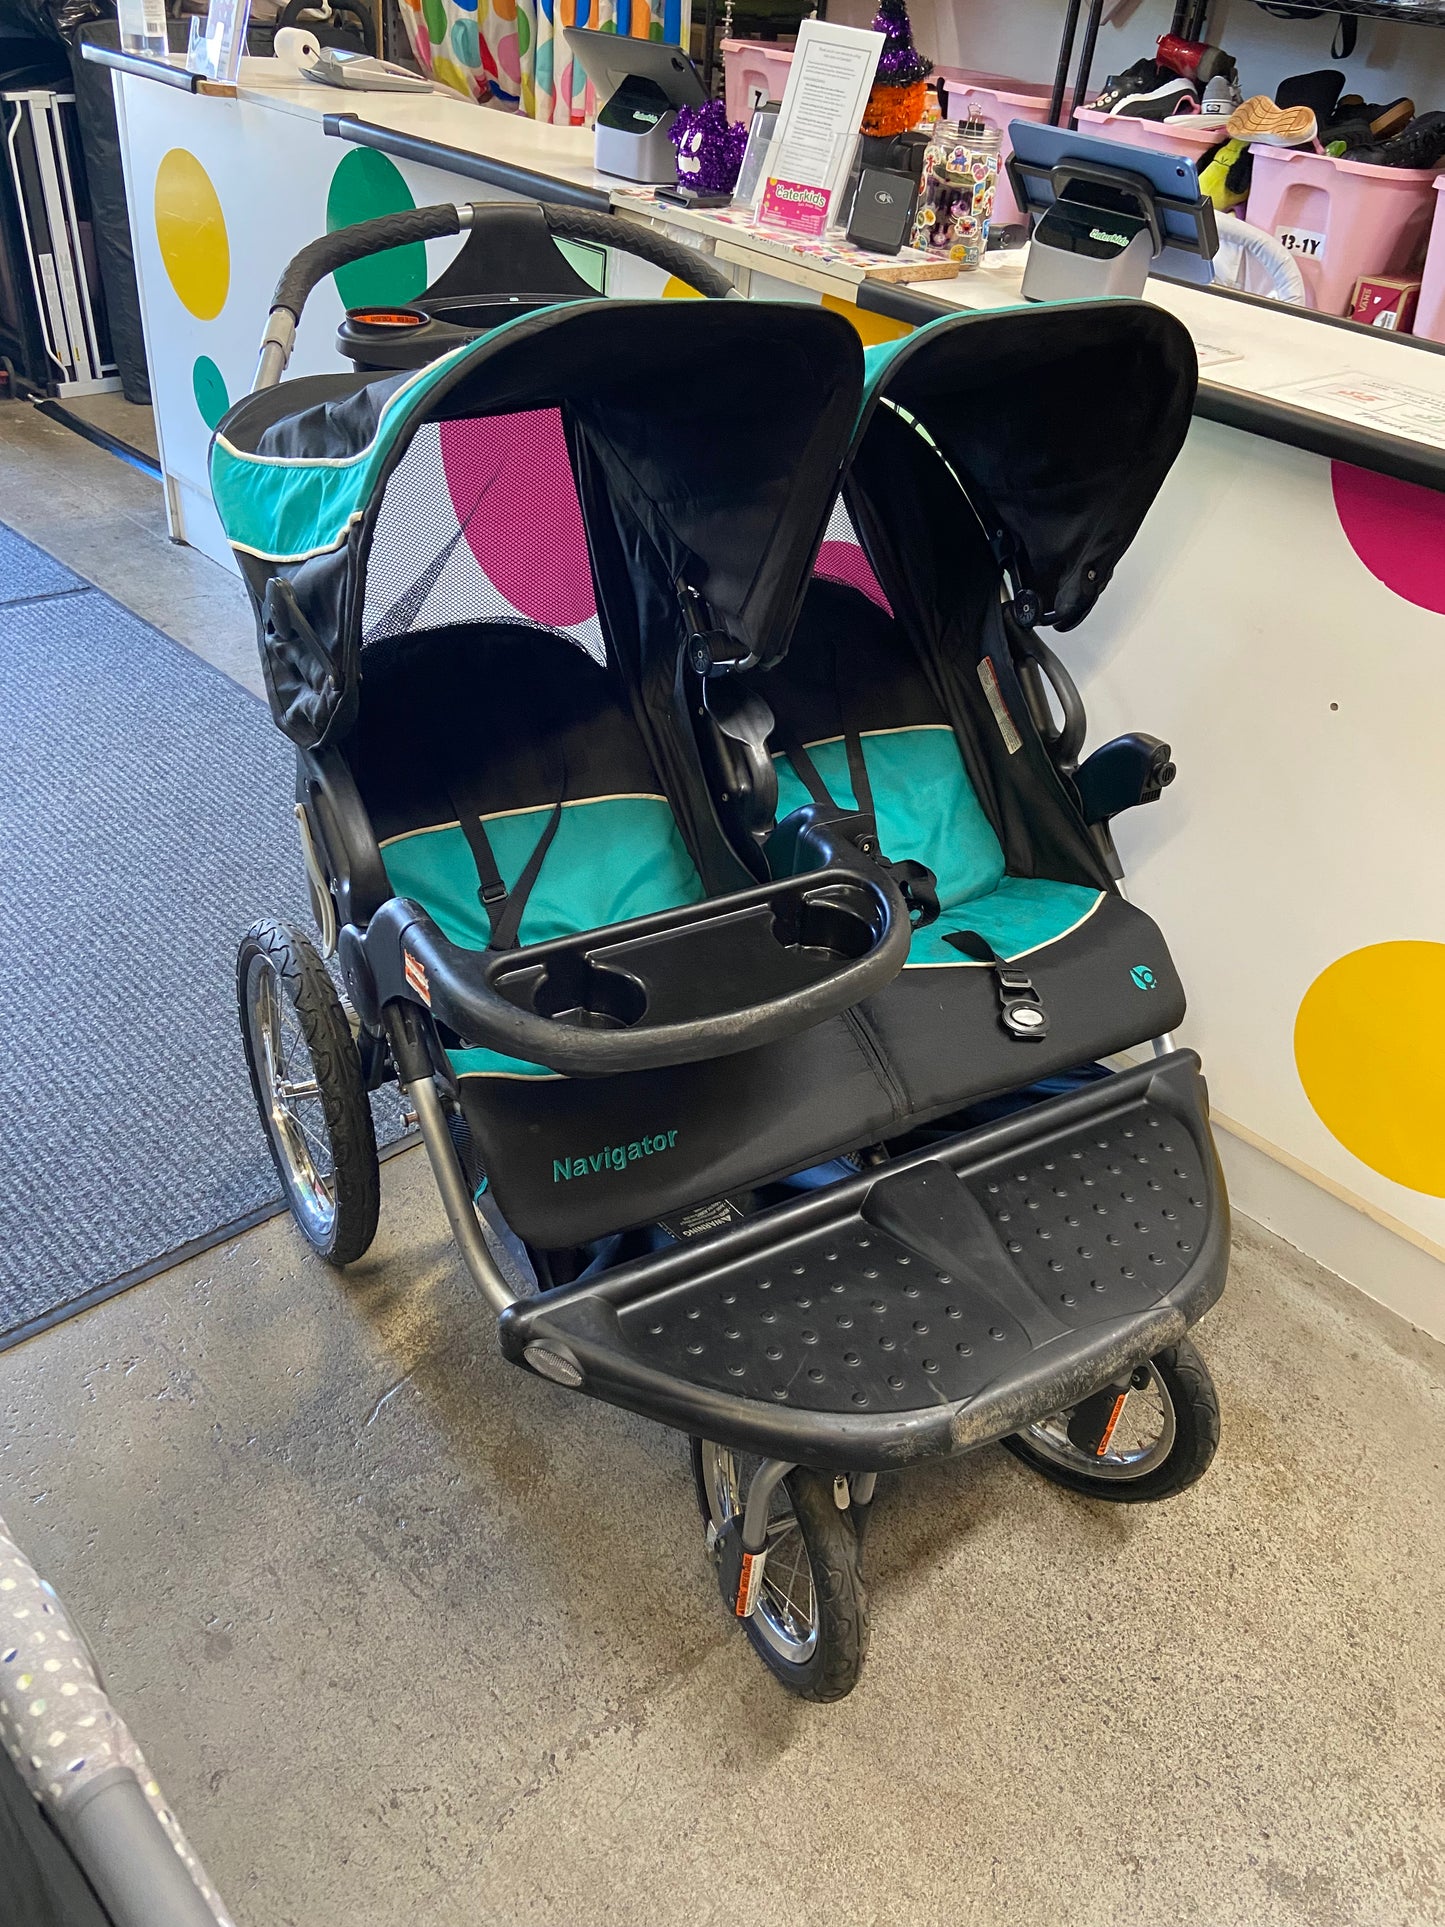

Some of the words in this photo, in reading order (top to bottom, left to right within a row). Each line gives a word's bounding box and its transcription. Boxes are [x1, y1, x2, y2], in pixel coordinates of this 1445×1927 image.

[775, 185, 826, 207] Caterkids
[1281, 234, 1321, 255] 13-1Y
[1357, 288, 1373, 313] VANS
[552, 1129, 678, 1183] Navigator
